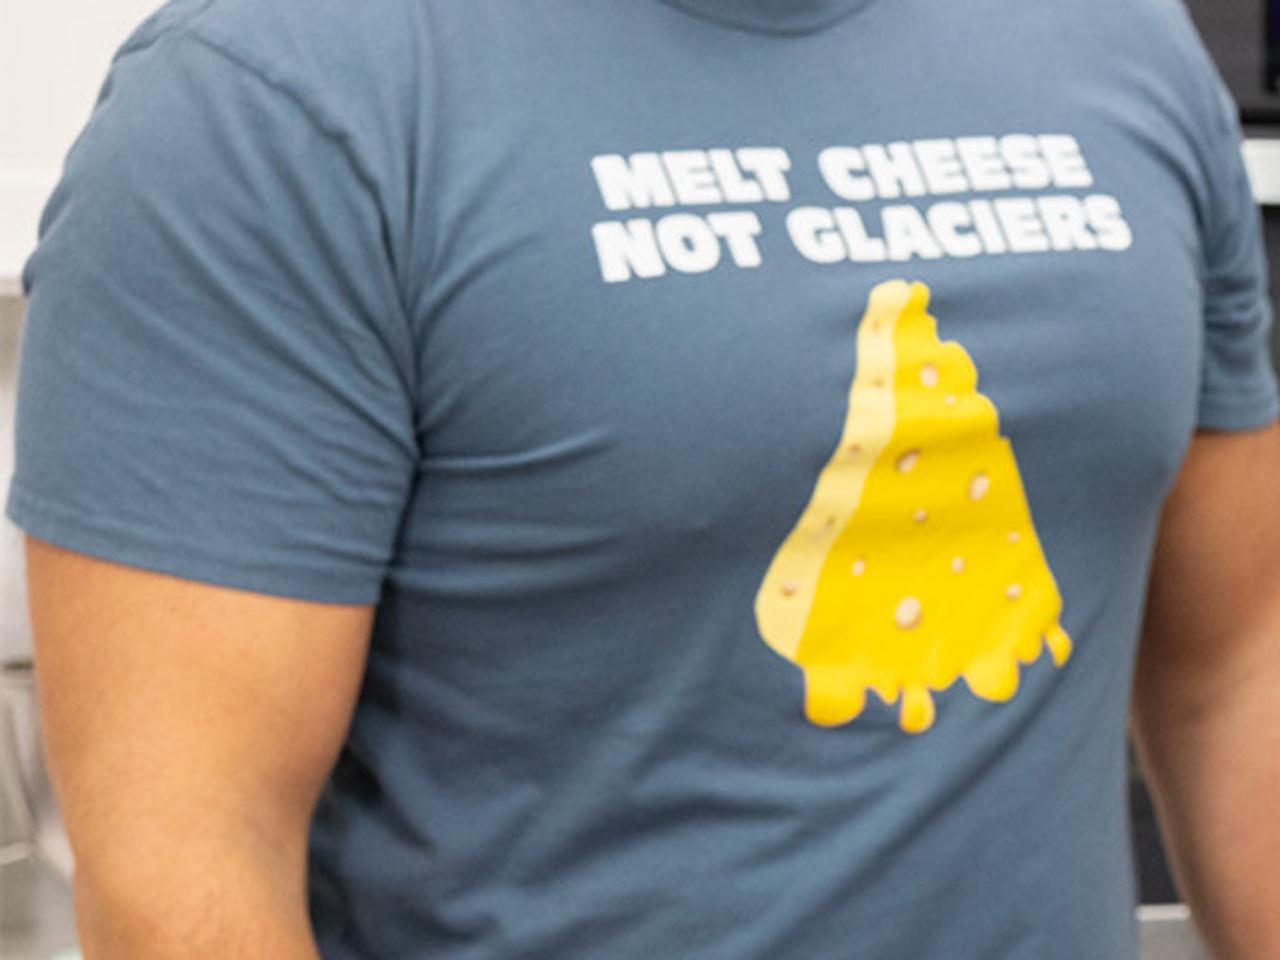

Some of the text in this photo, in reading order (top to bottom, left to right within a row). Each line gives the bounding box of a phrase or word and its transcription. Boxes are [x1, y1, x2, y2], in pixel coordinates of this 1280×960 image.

[590, 134, 1094, 210] MELT CHEESE
[591, 194, 1133, 283] NOT GLACIERS
